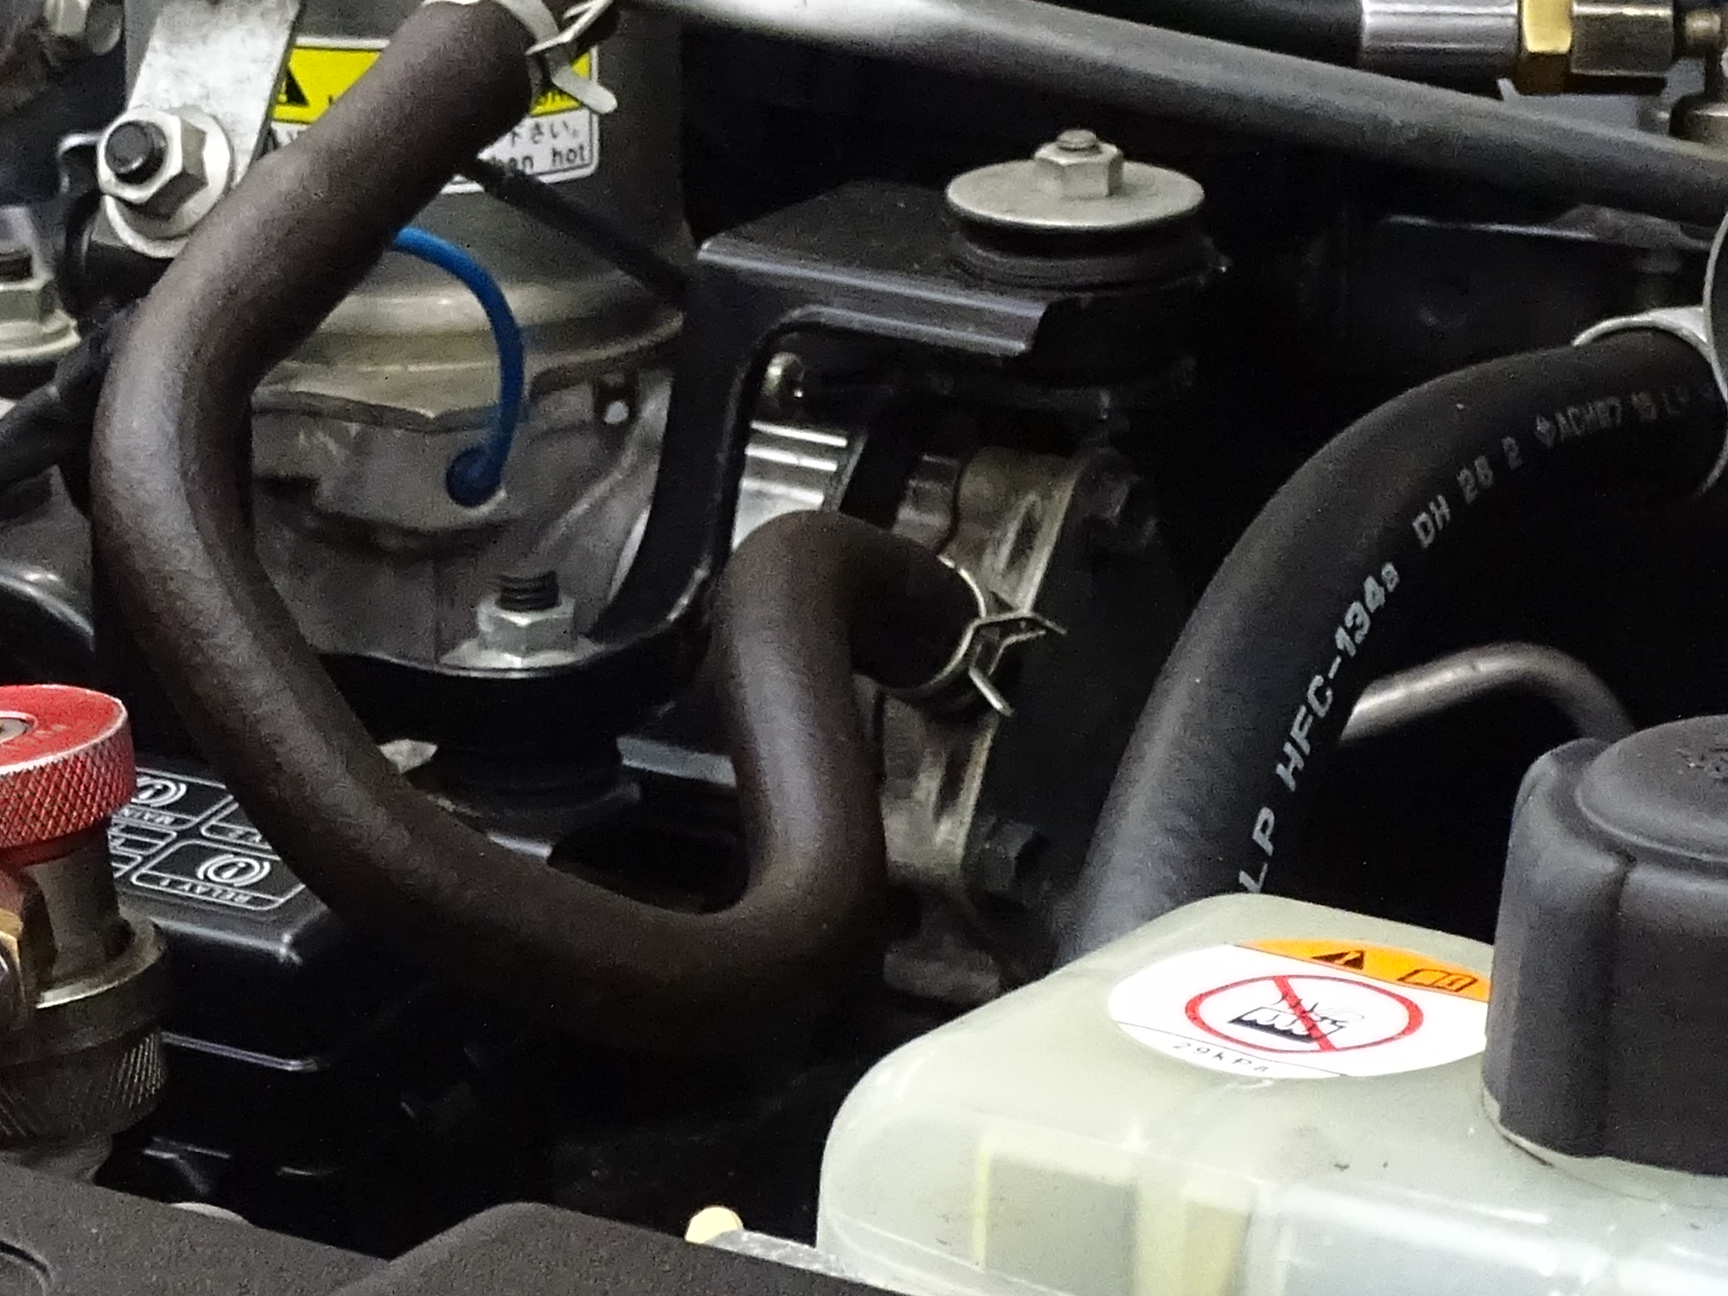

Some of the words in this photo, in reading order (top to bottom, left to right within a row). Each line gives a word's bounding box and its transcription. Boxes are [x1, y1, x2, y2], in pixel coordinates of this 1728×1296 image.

[551, 144, 586, 165] hot
[1275, 561, 1401, 791] HFC-134a
[178, 880, 253, 905] RELAY
